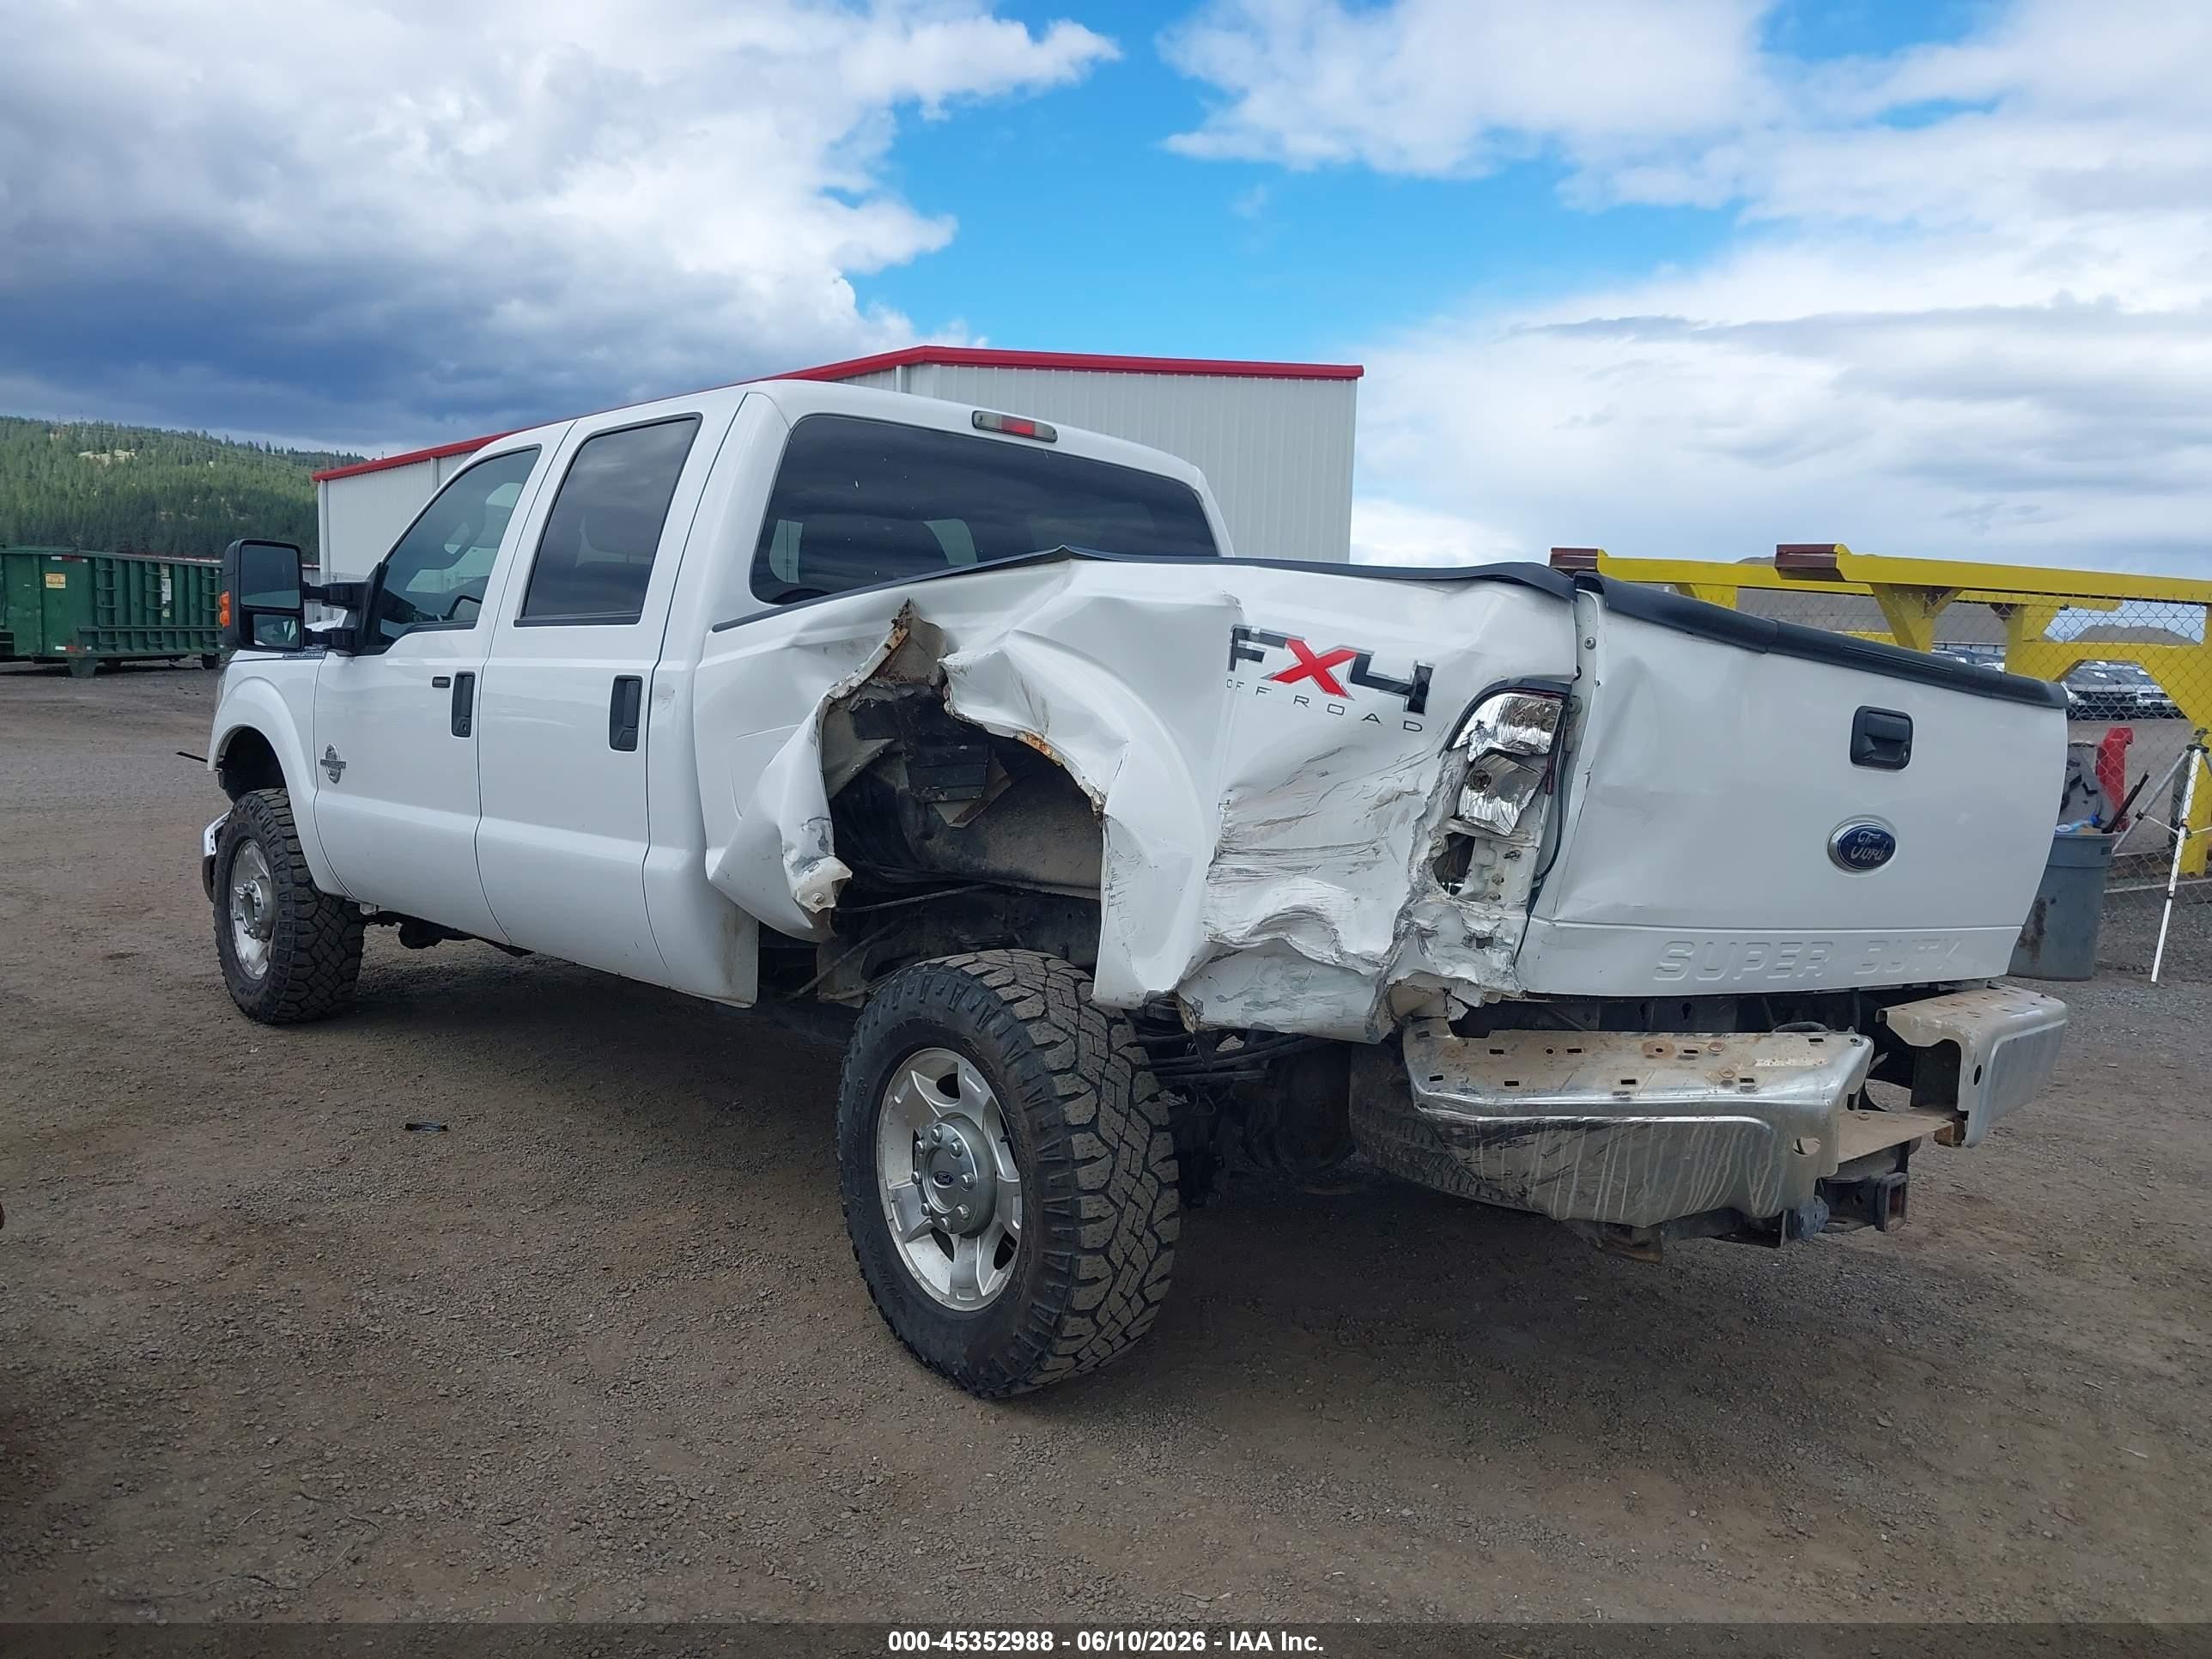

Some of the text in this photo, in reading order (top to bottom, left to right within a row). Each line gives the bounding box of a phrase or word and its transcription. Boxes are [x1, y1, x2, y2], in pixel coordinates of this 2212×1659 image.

[1228, 624, 1437, 716] FX4
[1292, 695, 1425, 733] ROAD
[1850, 830, 1889, 861] Ford
[1651, 936, 1965, 982] SUPER DUTY
